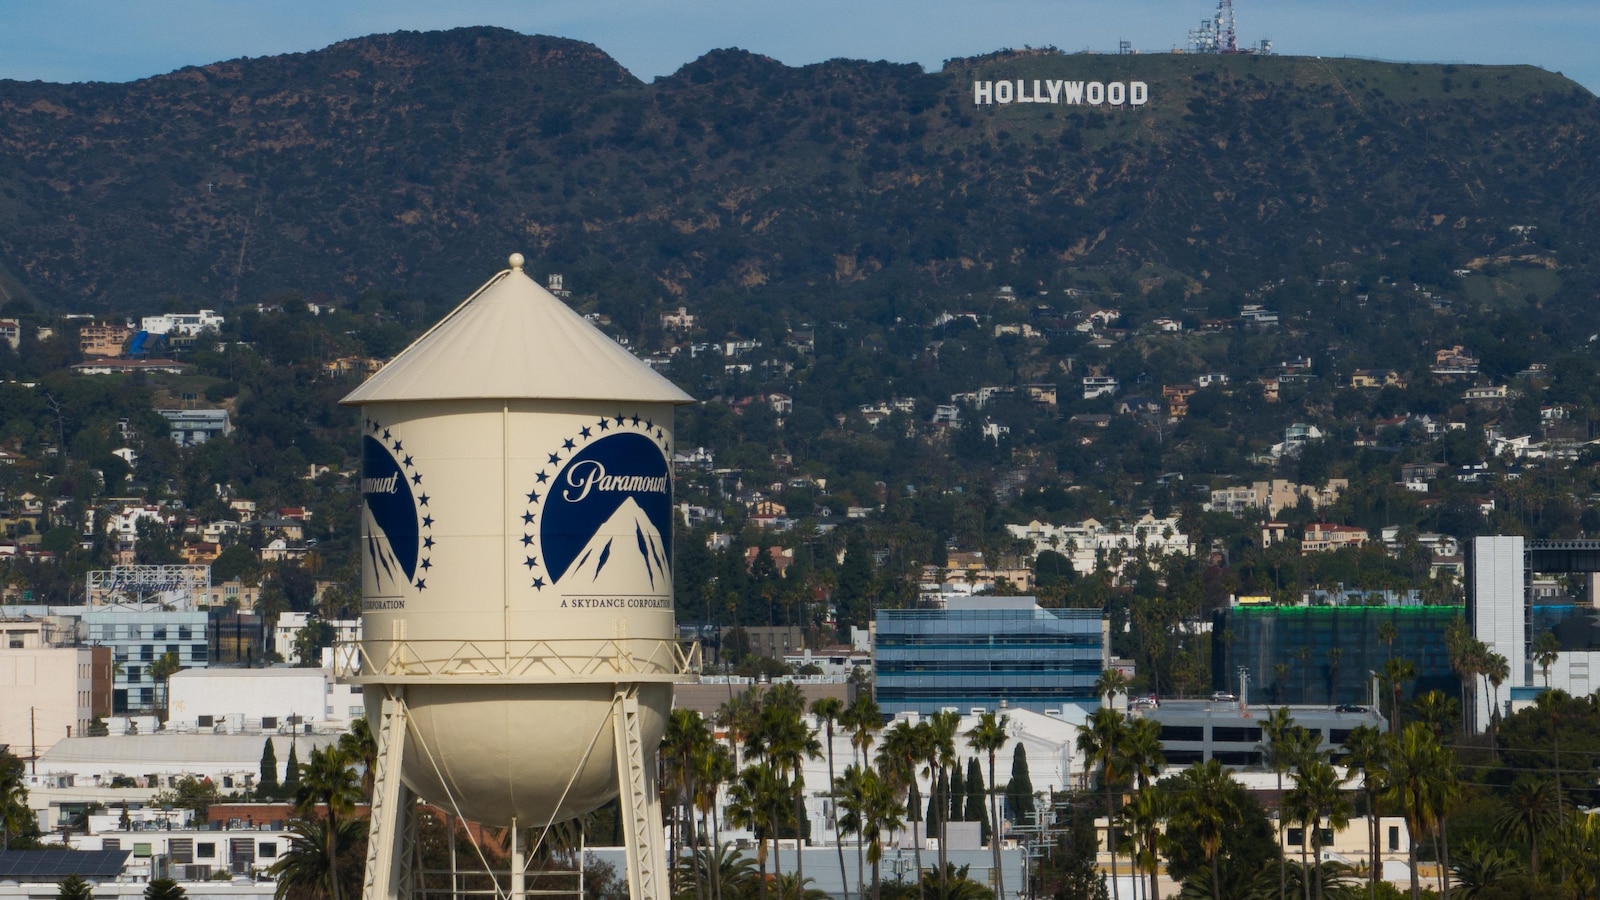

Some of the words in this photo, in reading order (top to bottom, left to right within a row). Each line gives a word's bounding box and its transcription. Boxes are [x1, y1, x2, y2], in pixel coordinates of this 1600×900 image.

[974, 79, 1148, 105] HOLLYWOOD
[563, 460, 668, 503] Paramount
[560, 599, 568, 608] A
[571, 599, 626, 608] SKYDANCE
